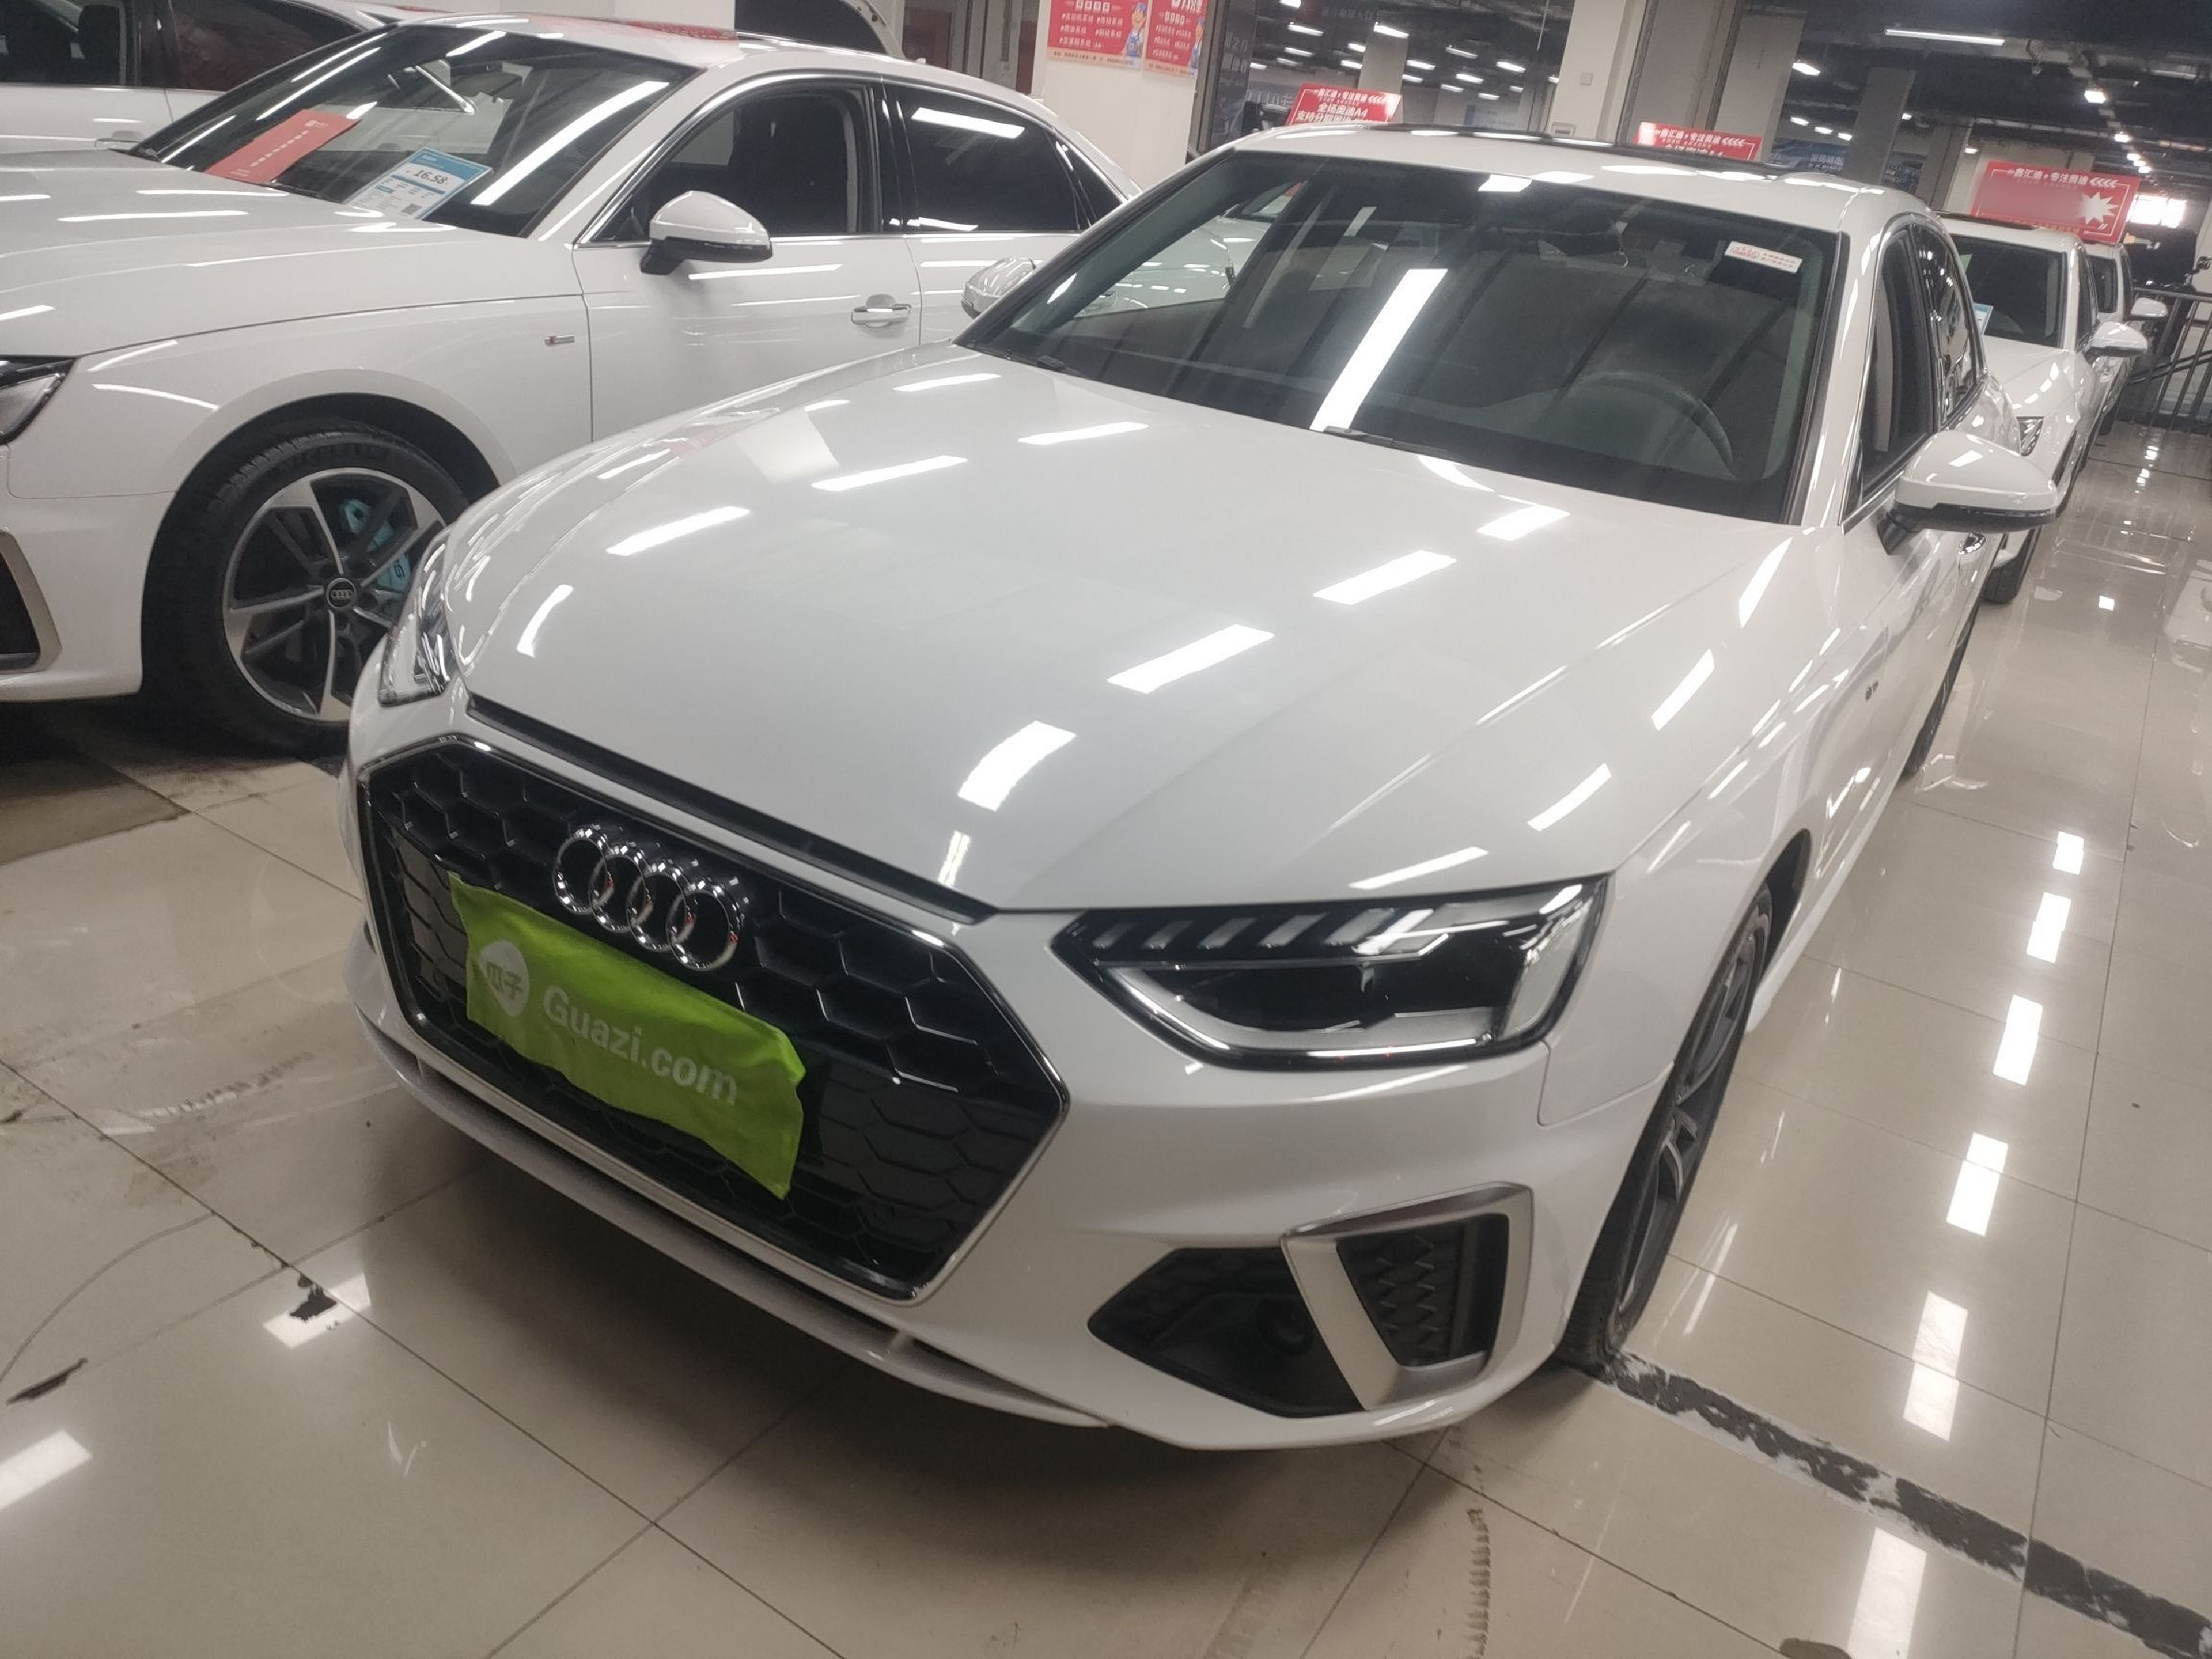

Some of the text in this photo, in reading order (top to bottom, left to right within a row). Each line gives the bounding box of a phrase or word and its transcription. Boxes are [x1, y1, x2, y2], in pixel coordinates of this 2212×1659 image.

[1317, 102, 1368, 117] 全场奥迪A4
[414, 169, 449, 184] 16.58
[487, 963, 521, 998] 瓜子
[543, 986, 737, 1105] Guazi.com
